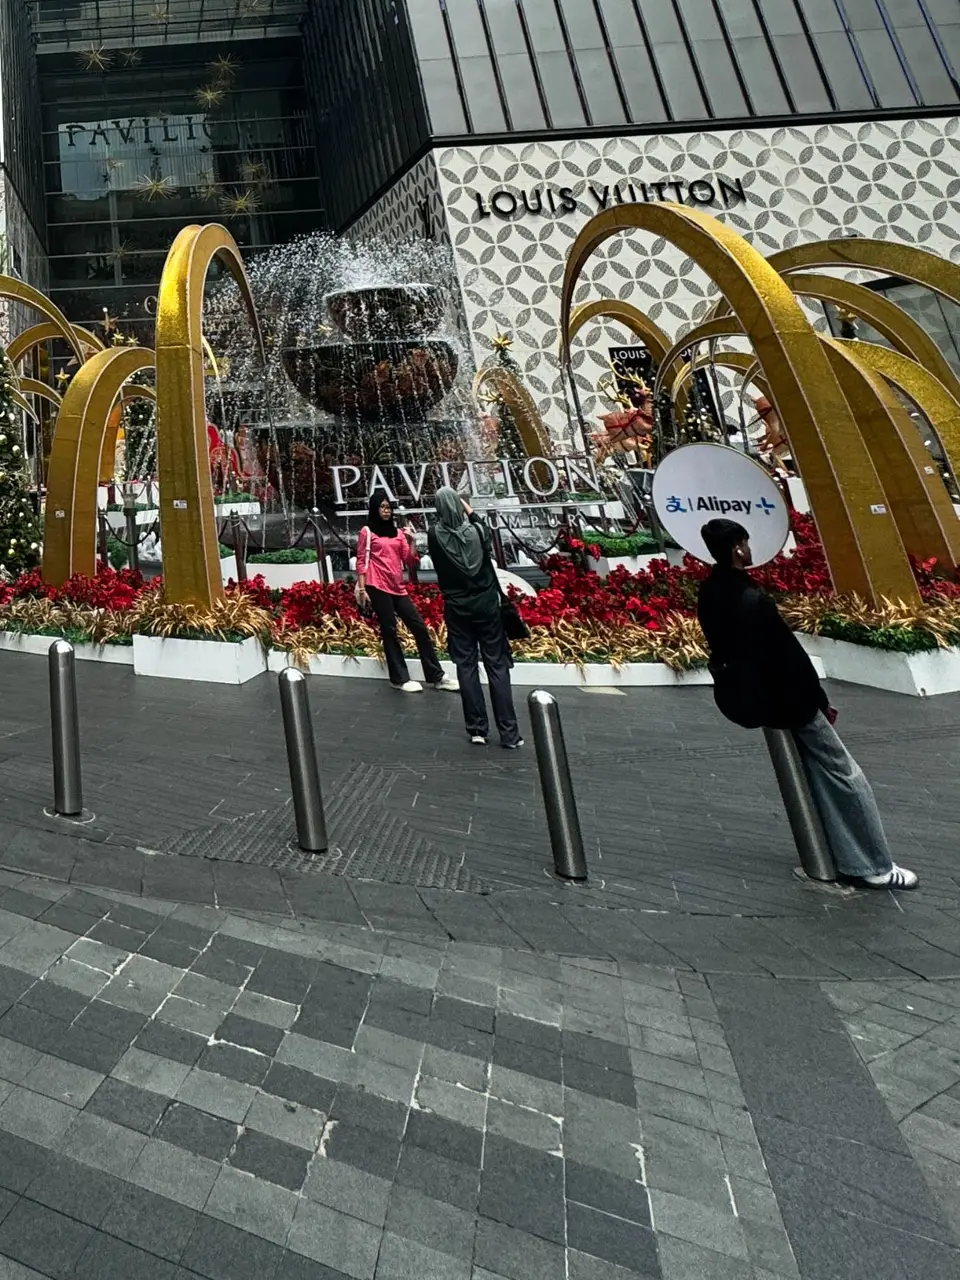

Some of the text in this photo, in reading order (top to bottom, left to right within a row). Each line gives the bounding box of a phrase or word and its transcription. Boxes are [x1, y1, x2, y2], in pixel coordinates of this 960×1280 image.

[475, 177, 748, 220] LOUIS VUITTON
[613, 350, 647, 360] LOUIS
[331, 455, 601, 505] PAVILION
[488, 514, 579, 530] UMPUR
